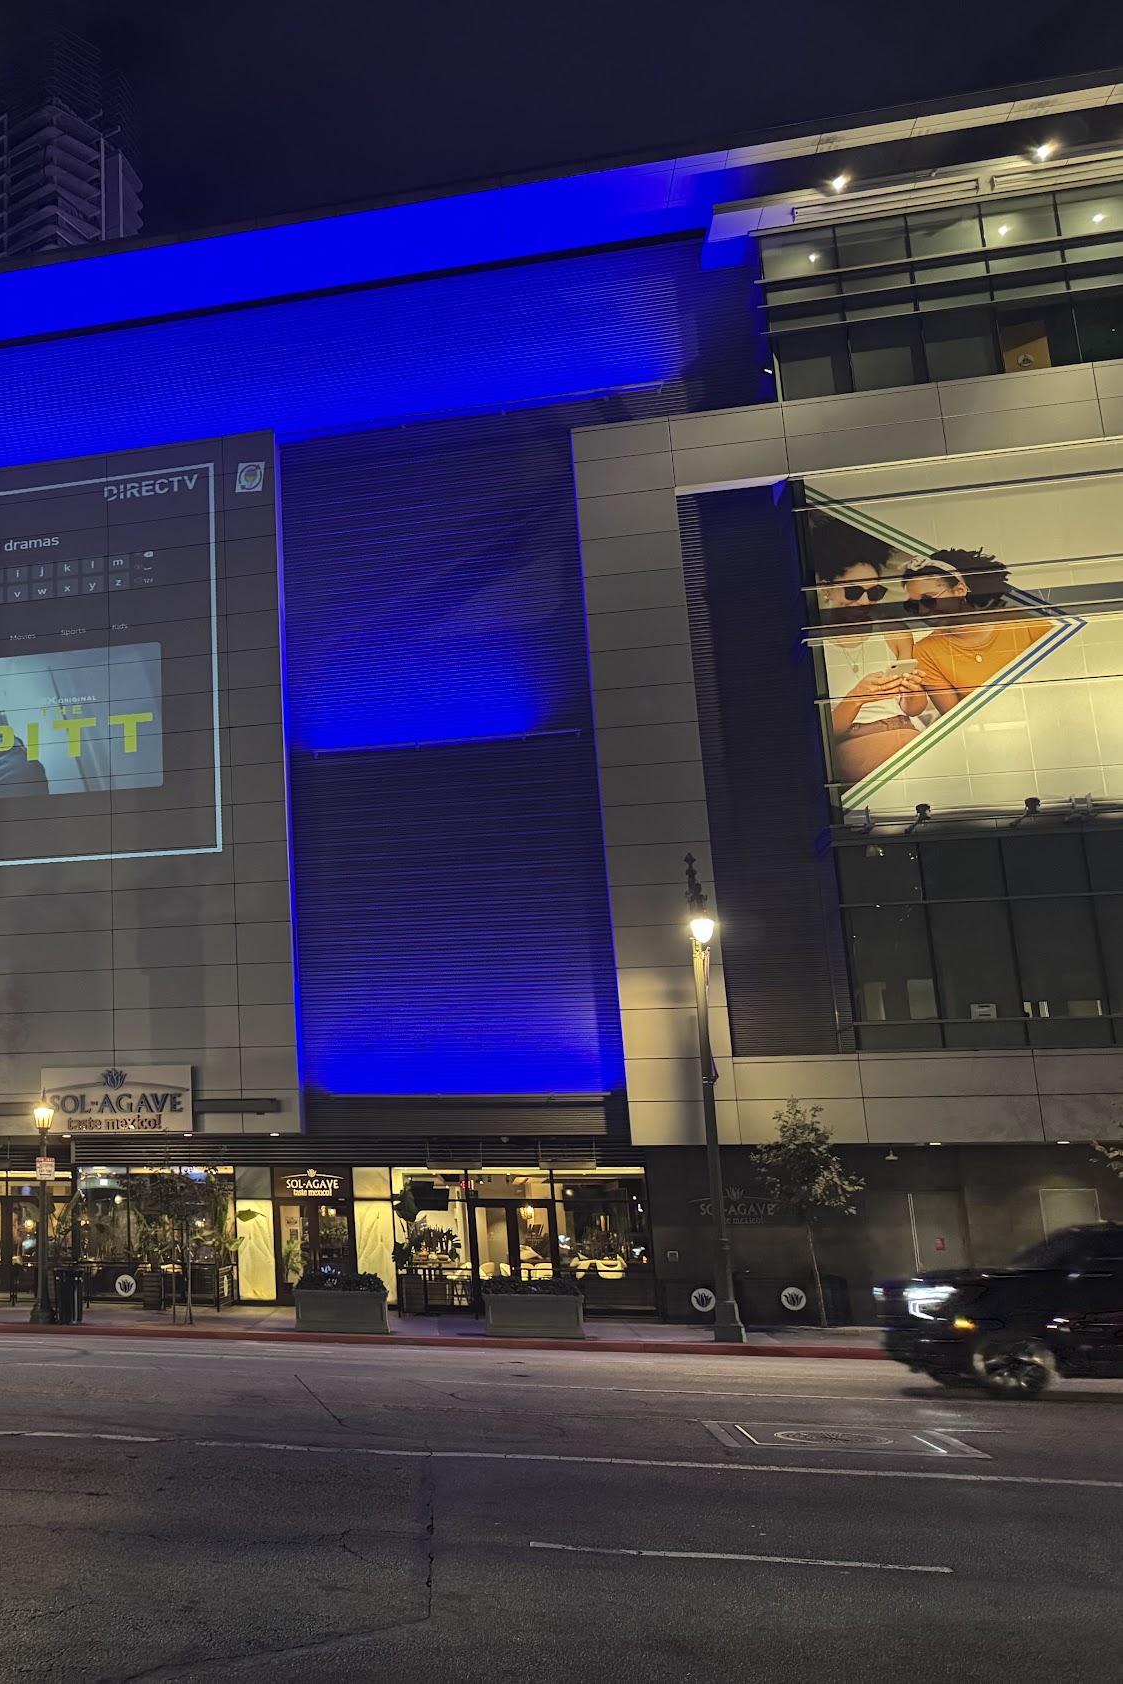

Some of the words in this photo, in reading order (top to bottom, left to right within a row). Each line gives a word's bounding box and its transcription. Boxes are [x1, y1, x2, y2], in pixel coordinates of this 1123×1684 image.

[103, 473, 199, 502] DIRECTV
[4, 535, 60, 552] dramas
[10, 633, 36, 641] Movies
[60, 627, 86, 636] Sports
[40, 705, 82, 716] THE
[67, 1116, 102, 1130] taste
[104, 1114, 162, 1130] mexico!
